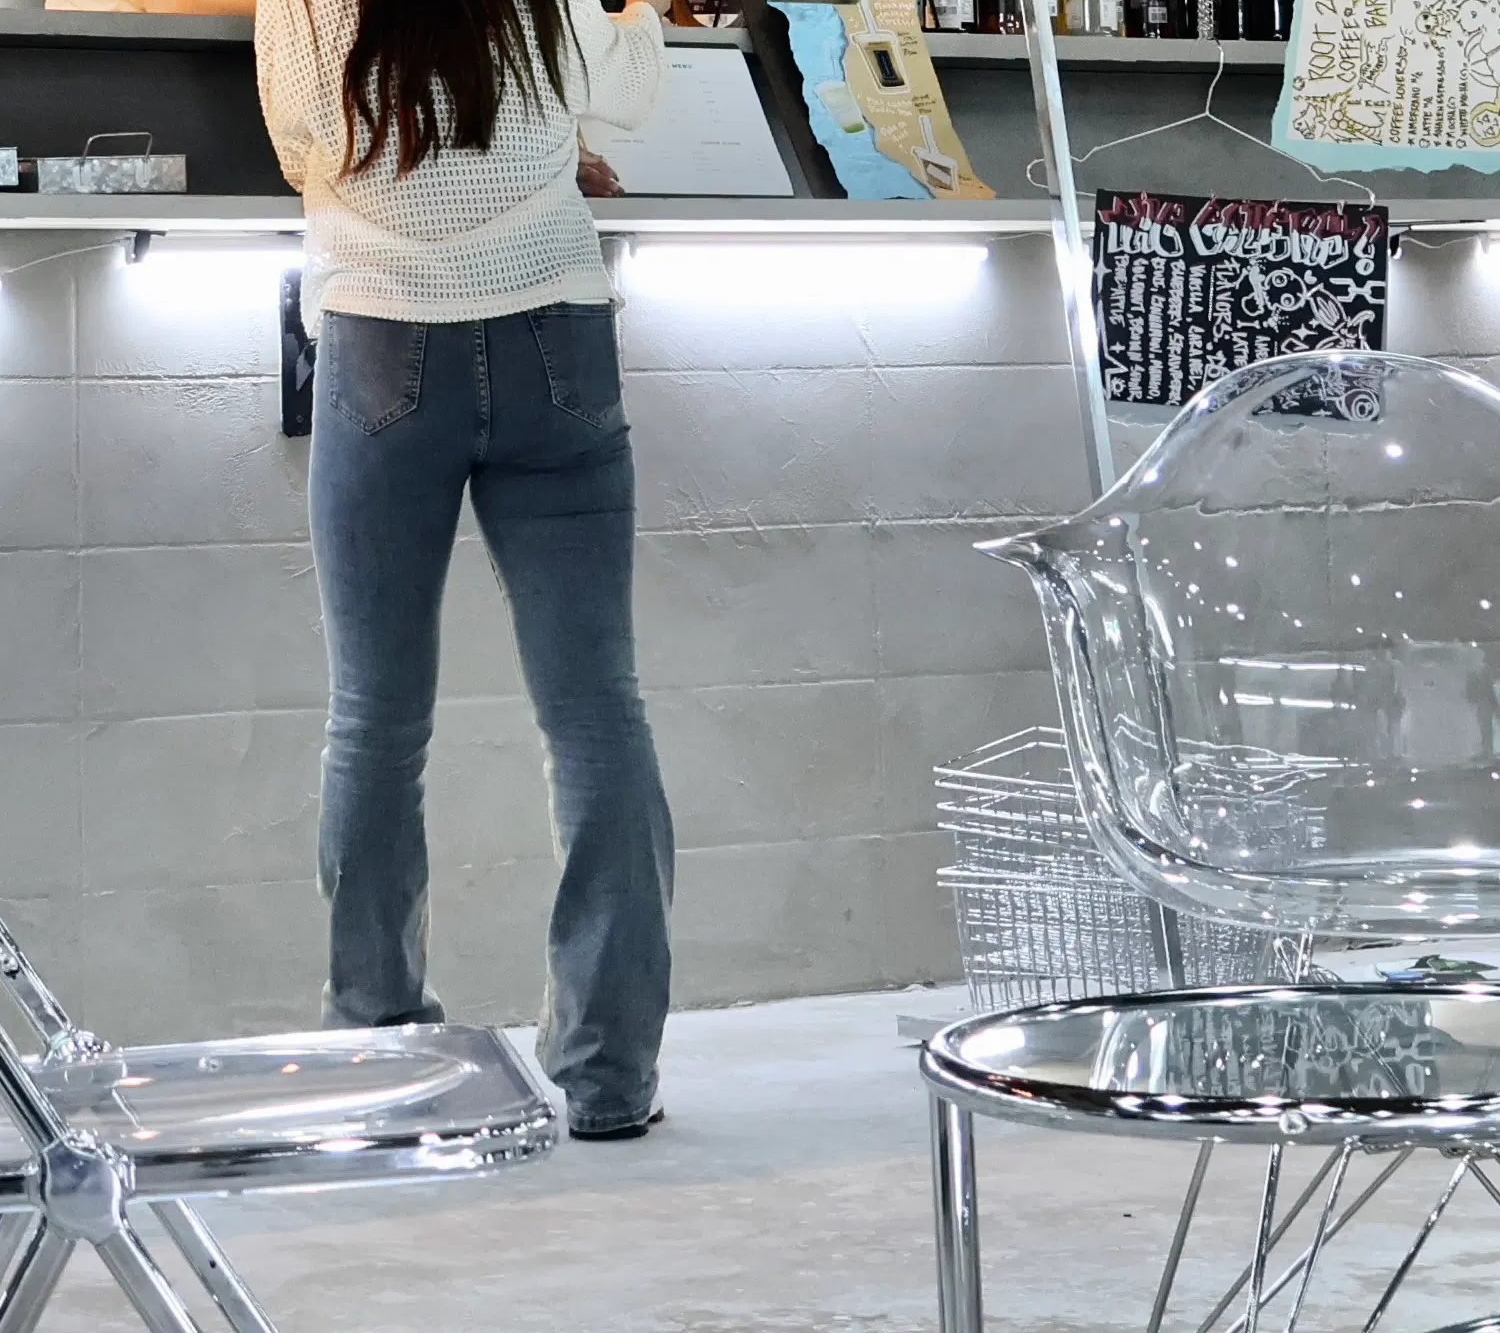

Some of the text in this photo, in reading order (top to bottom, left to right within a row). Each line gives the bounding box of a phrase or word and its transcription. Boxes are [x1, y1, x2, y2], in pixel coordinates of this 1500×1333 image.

[1308, 23, 1337, 81] ROOT
[1336, 17, 1362, 83] COFFEE
[1389, 102, 1405, 143] COFFEE
[1422, 111, 1433, 137] LATTE
